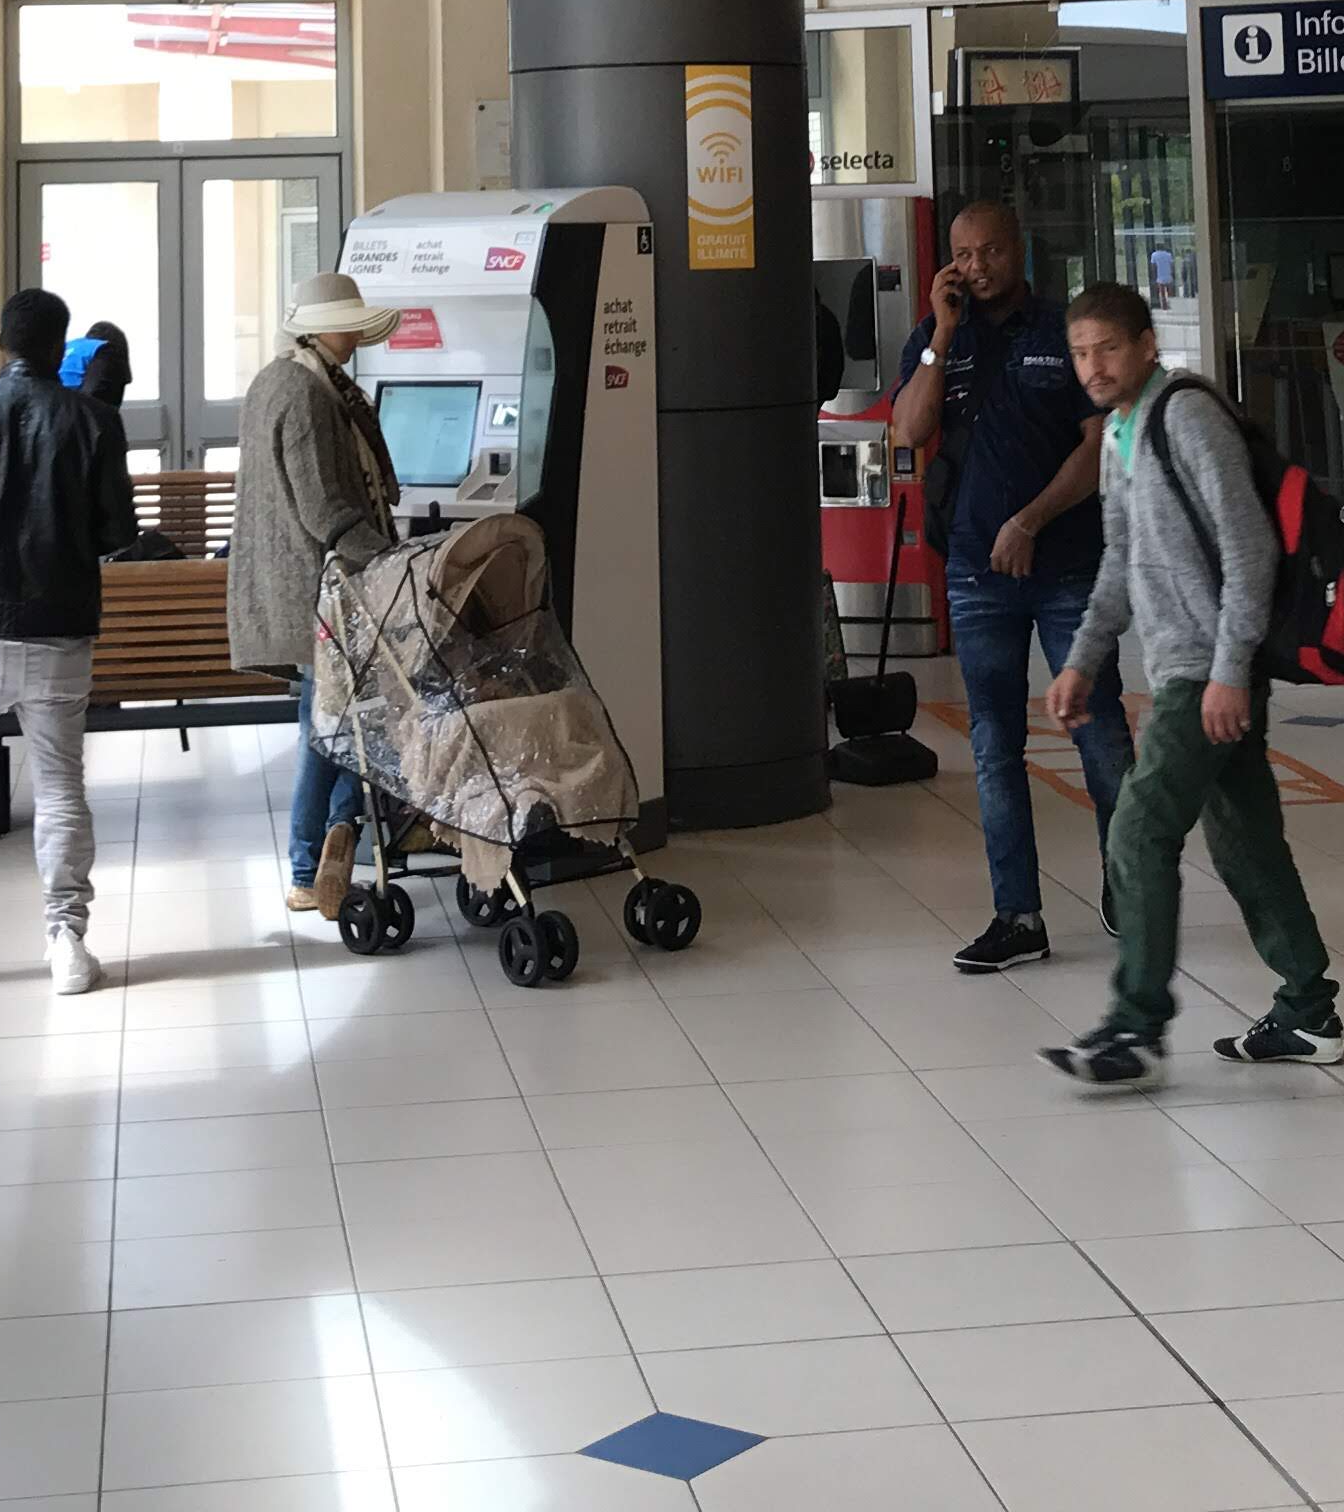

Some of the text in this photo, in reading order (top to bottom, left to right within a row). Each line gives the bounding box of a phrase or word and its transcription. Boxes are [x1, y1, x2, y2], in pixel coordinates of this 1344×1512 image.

[820, 149, 895, 171] selecta
[352, 240, 388, 251] BILLETS
[416, 240, 443, 251] achat
[350, 252, 398, 263] GRANDES
[413, 251, 444, 262] retrait
[486, 255, 524, 270] SNCF
[348, 263, 383, 275] LIGNES
[411, 263, 450, 275] échange
[603, 298, 633, 314] achat
[603, 317, 638, 335] retrait
[604, 337, 647, 357] échange
[605, 373, 629, 387] SNCF
